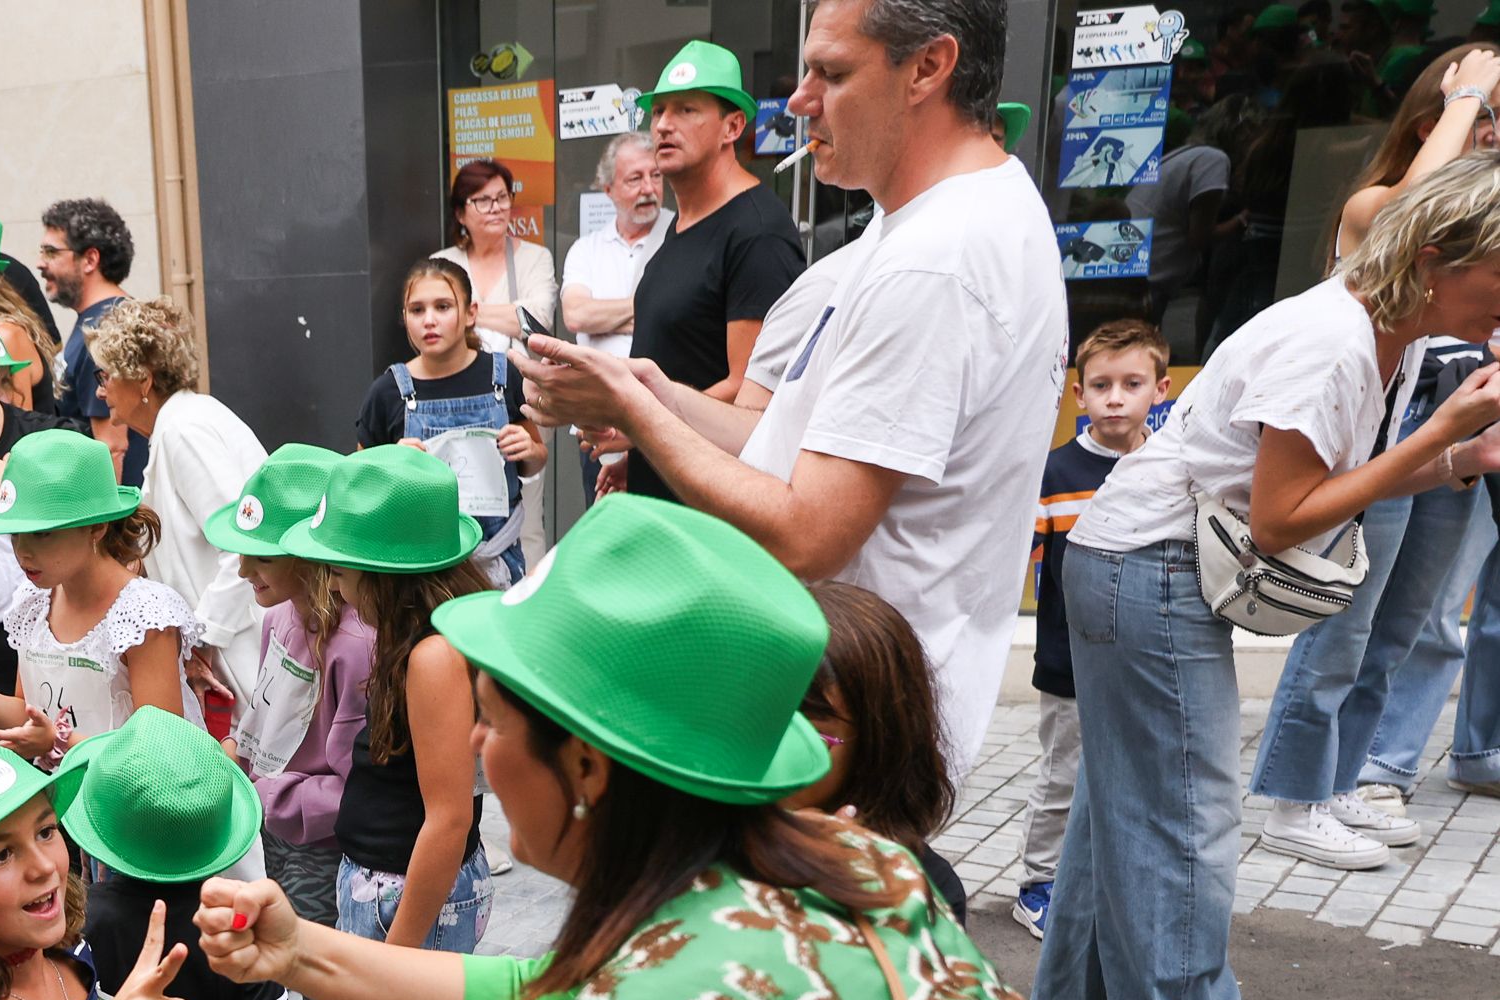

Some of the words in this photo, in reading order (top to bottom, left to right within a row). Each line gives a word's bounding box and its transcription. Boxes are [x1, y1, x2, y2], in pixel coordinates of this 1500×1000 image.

[1080, 13, 1111, 26] JMA
[1071, 72, 1095, 82] JMA
[454, 90, 500, 104] CARCASSA
[501, 88, 511, 101] DE
[513, 86, 537, 99] LLAVE
[760, 100, 780, 109] JMA
[454, 106, 479, 117] PILAS
[455, 117, 487, 130] PLACAS
[488, 116, 499, 128] DE
[455, 129, 496, 143] CUCHILLO
[497, 126, 536, 140] ESMOLAT
[1064, 131, 1089, 141] JMA
[455, 142, 494, 155] REMACHE
[1056, 225, 1079, 235] JMA
[1145, 407, 1170, 430] CIÓ
